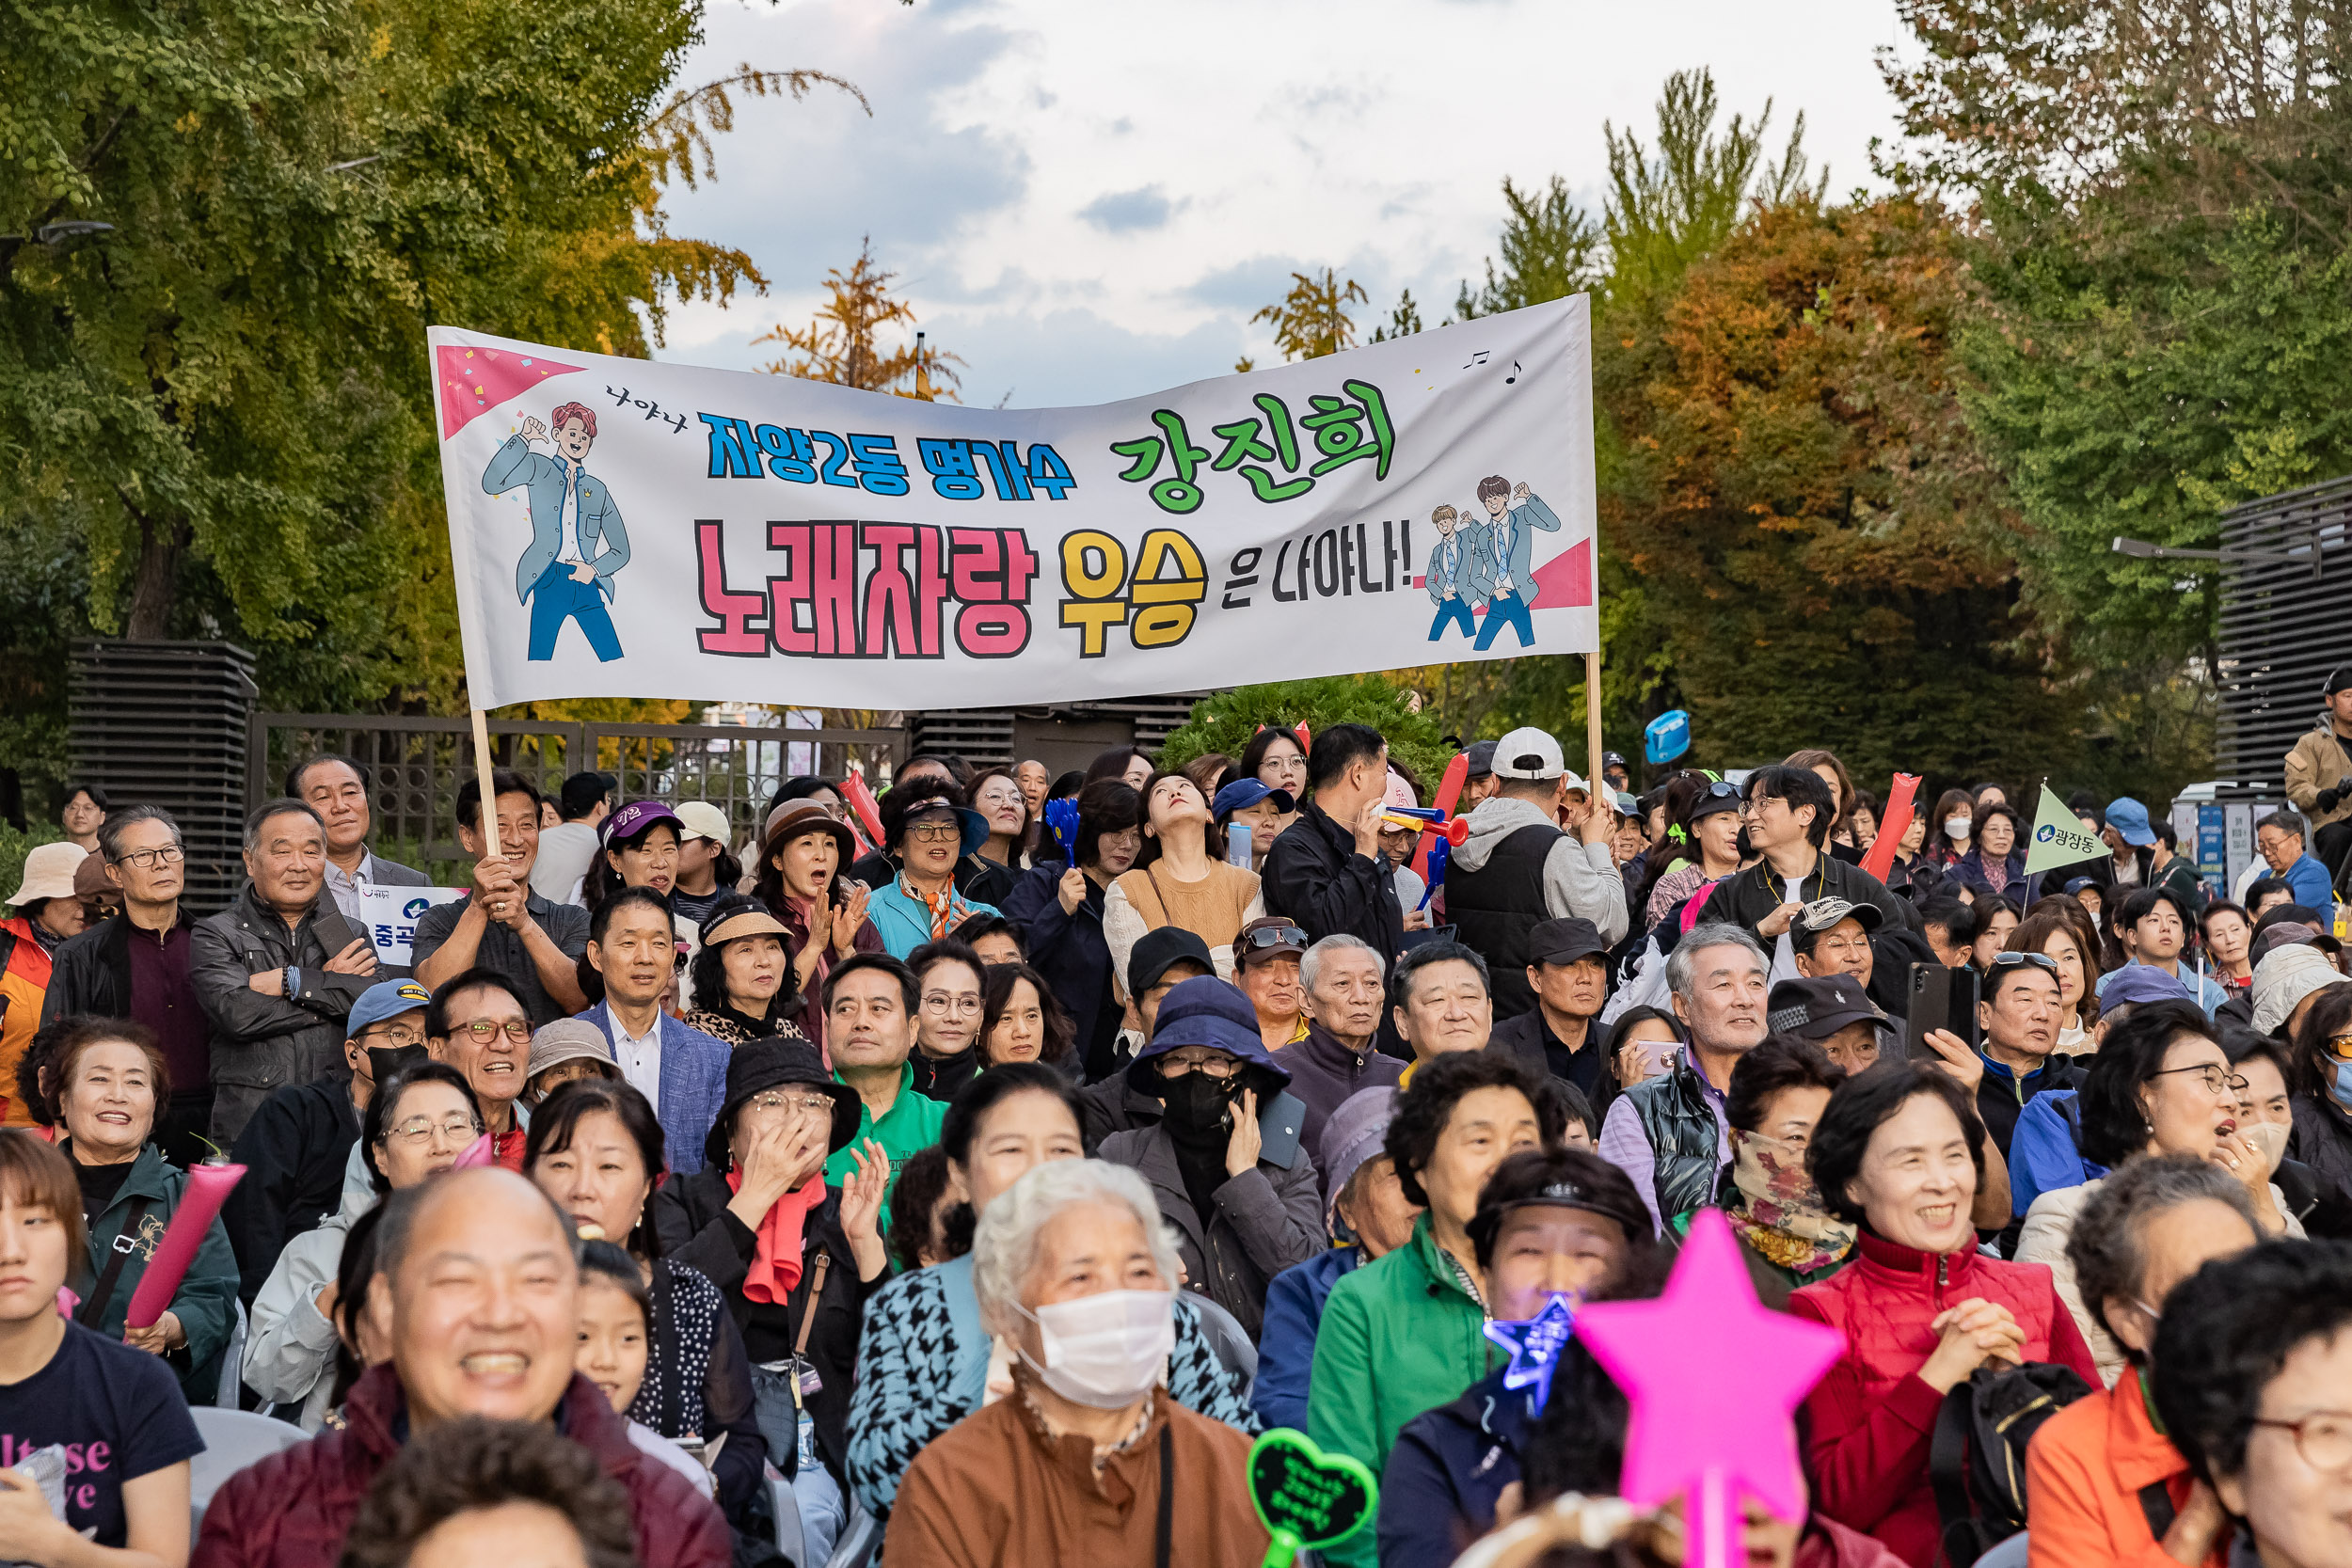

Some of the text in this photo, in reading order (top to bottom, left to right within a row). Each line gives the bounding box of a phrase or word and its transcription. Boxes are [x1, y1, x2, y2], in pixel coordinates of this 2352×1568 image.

[606, 384, 689, 434] 나야나
[697, 378, 1396, 515] 자양2동 명가수 강진희
[694, 519, 1412, 659] 노래자랑 우승 은 나야나!
[617, 806, 642, 826] 72
[2055, 829, 2094, 854] 광장동
